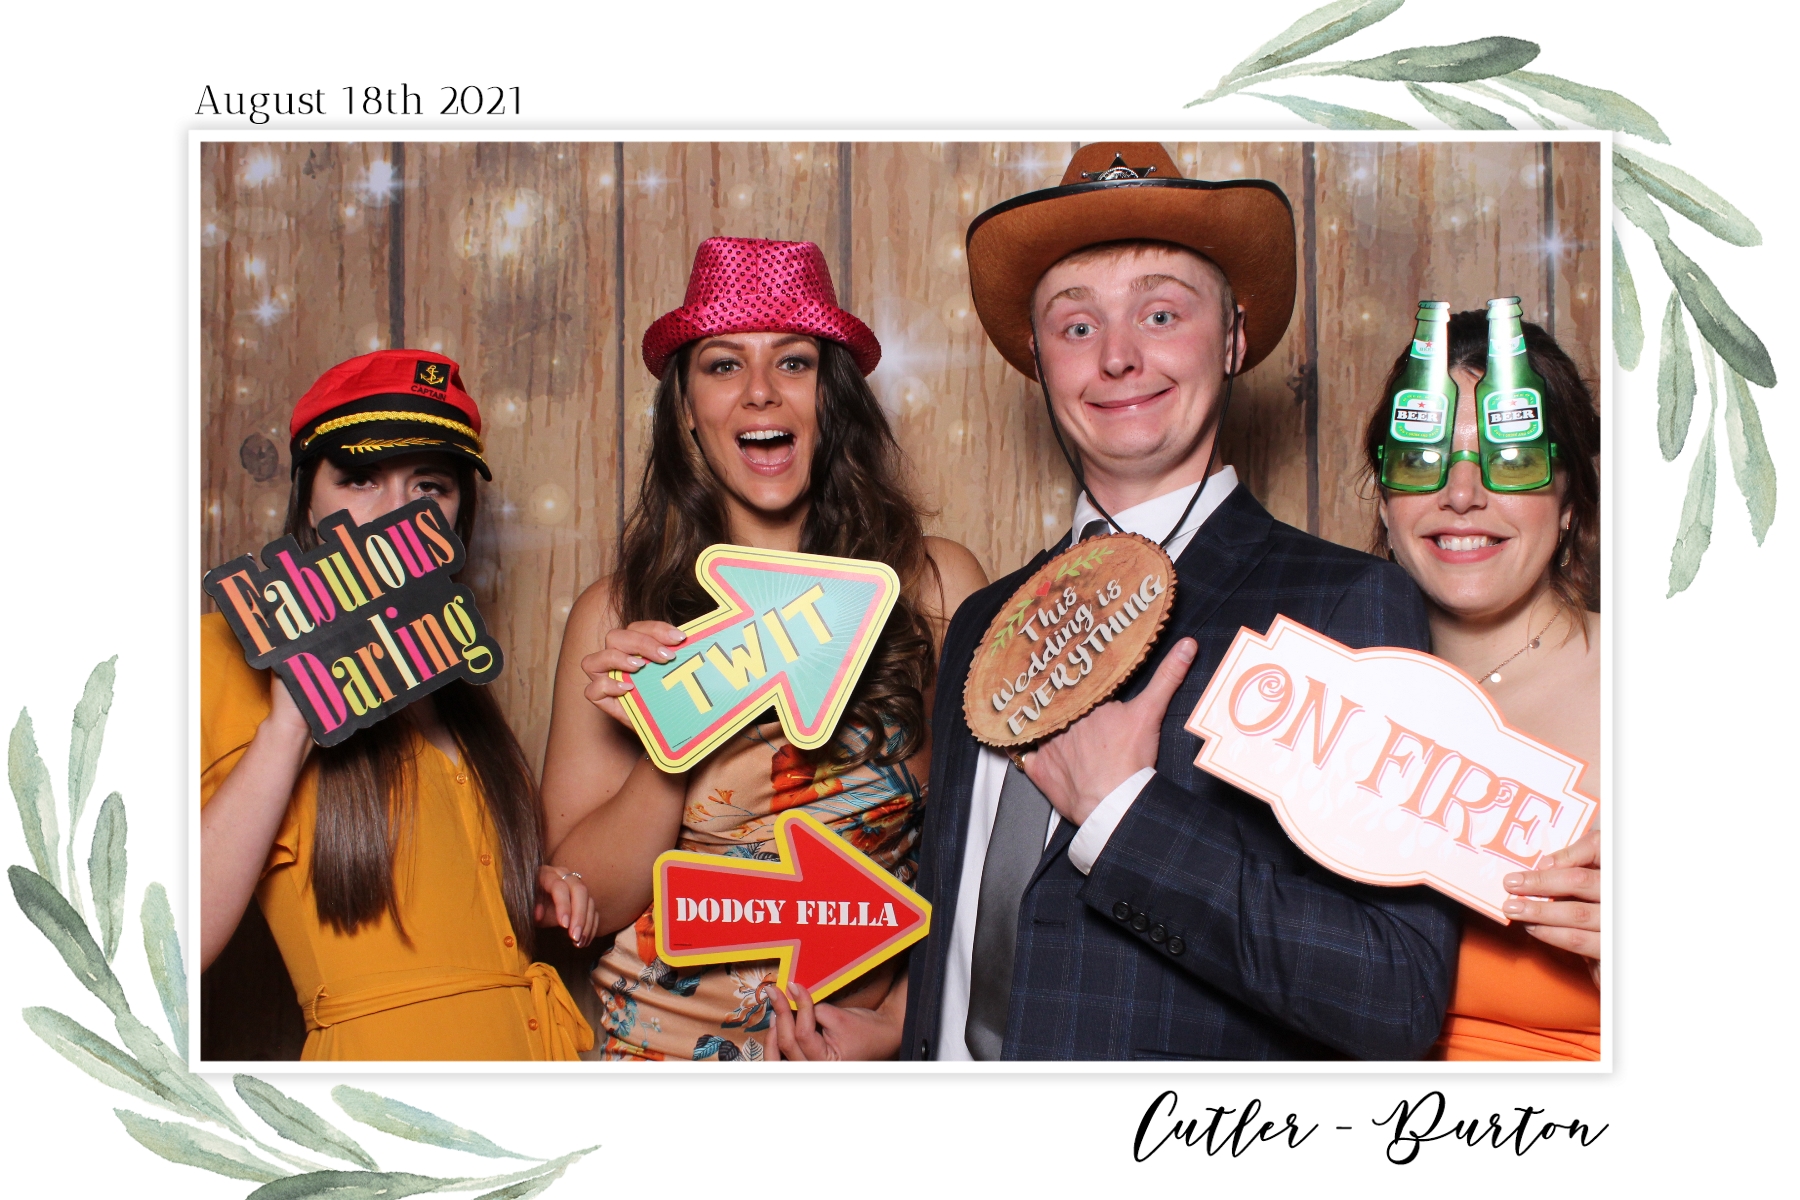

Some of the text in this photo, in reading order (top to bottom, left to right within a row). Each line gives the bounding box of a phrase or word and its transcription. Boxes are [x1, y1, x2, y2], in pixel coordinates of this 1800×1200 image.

[410, 385, 447, 402] CAPTAIN
[1396, 410, 1439, 423] BEER
[1490, 409, 1536, 423] BEER
[217, 508, 455, 657] Fabulous
[1095, 578, 1122, 607] is
[1017, 585, 1078, 642] This
[283, 595, 494, 735] Darling
[661, 581, 834, 715] TWIT
[1007, 573, 1167, 736] EVERYTHING
[1228, 662, 1564, 871] ON FIRE
[675, 897, 899, 927] DODGY FELLA
